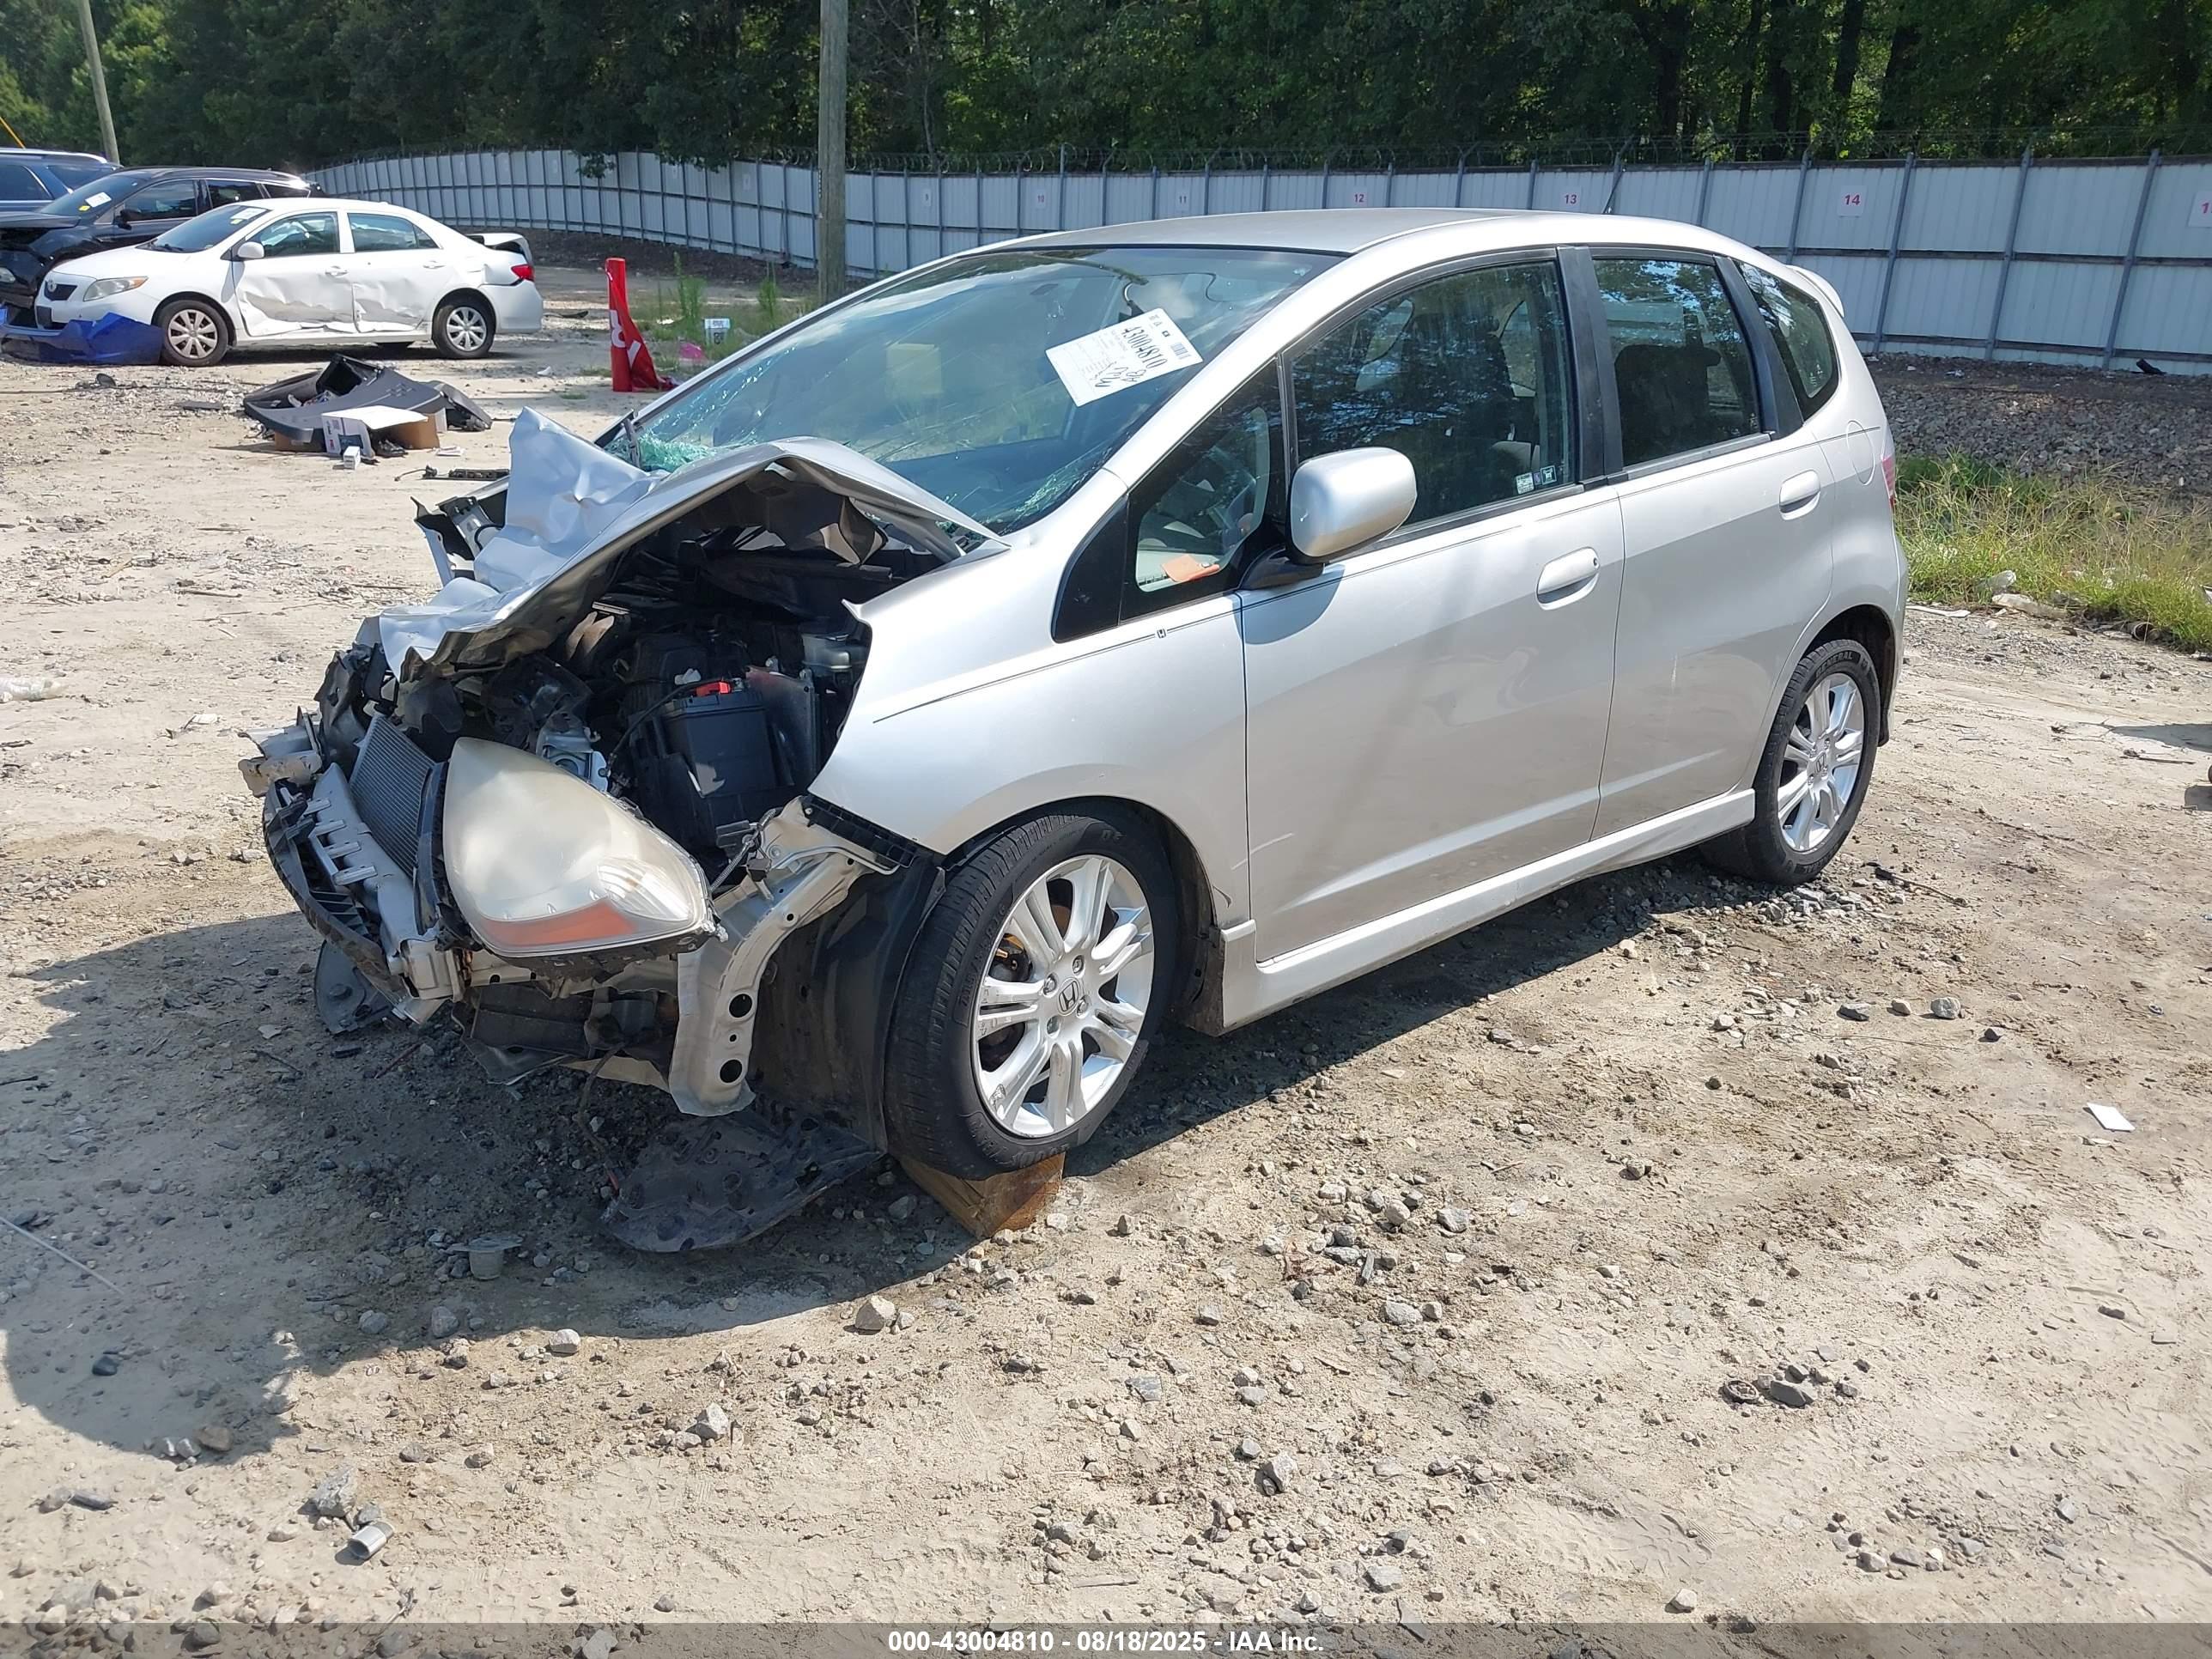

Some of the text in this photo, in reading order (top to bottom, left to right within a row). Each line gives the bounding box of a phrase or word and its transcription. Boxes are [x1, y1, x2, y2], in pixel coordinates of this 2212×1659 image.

[1179, 195, 1187, 204] 11
[1354, 193, 1364, 203] 12
[1565, 194, 1577, 204] 13
[1844, 194, 1861, 205] 14
[2202, 202, 2212, 214] 1
[1121, 326, 1168, 369] 43004810
